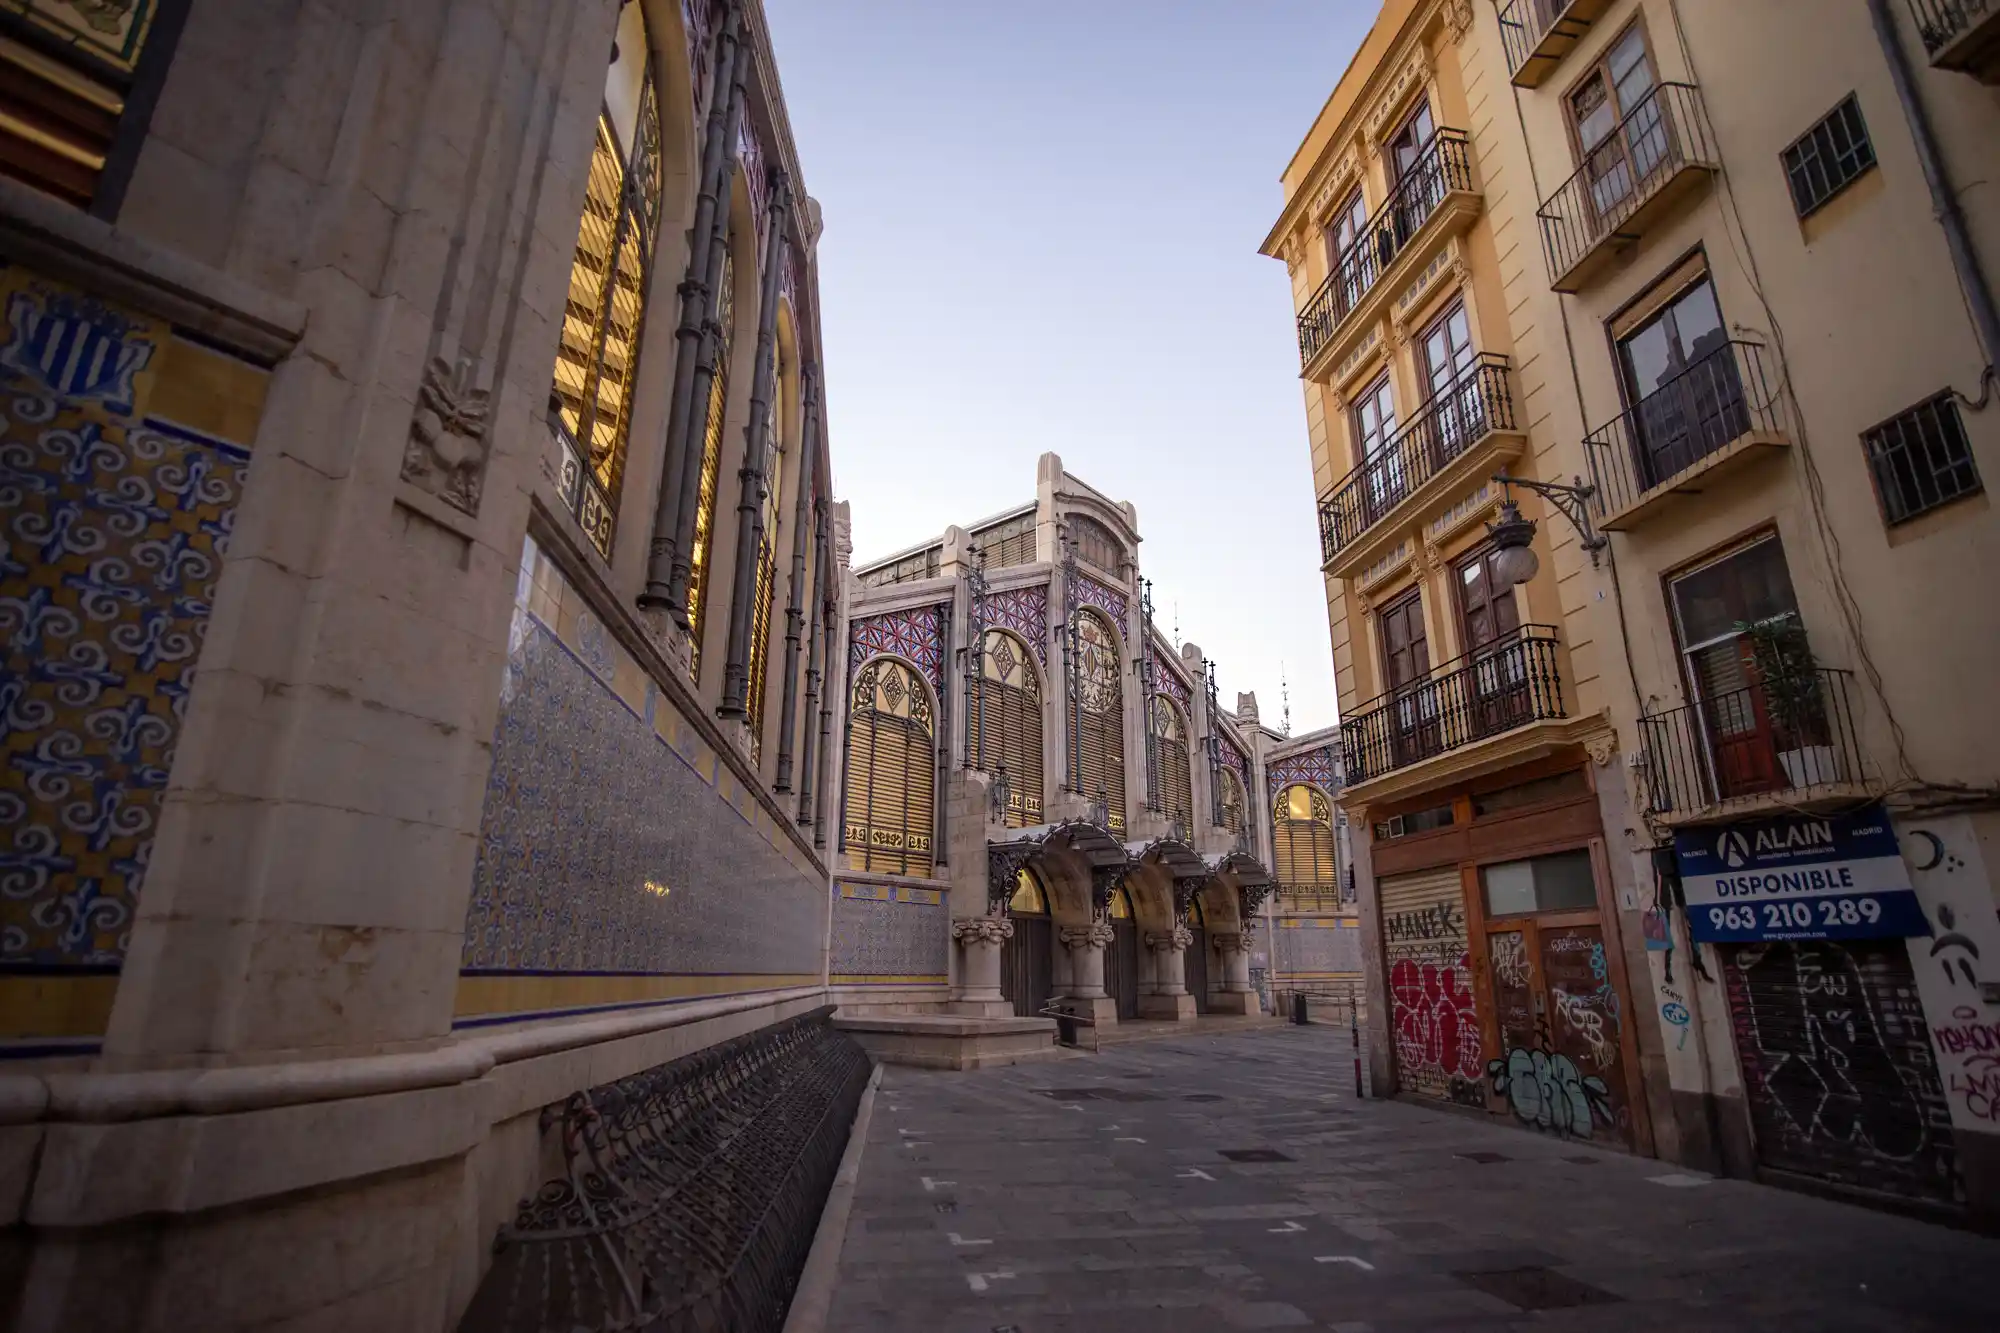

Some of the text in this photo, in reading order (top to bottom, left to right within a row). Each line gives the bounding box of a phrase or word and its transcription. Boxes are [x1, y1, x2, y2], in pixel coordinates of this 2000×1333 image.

[1755, 821, 1834, 851] ALAIN
[1852, 826, 1883, 837] MADRID
[1682, 849, 1708, 858] VALENCIA
[1716, 868, 1854, 897] DISPONIBLE
[1709, 898, 1882, 930] 963 210 289
